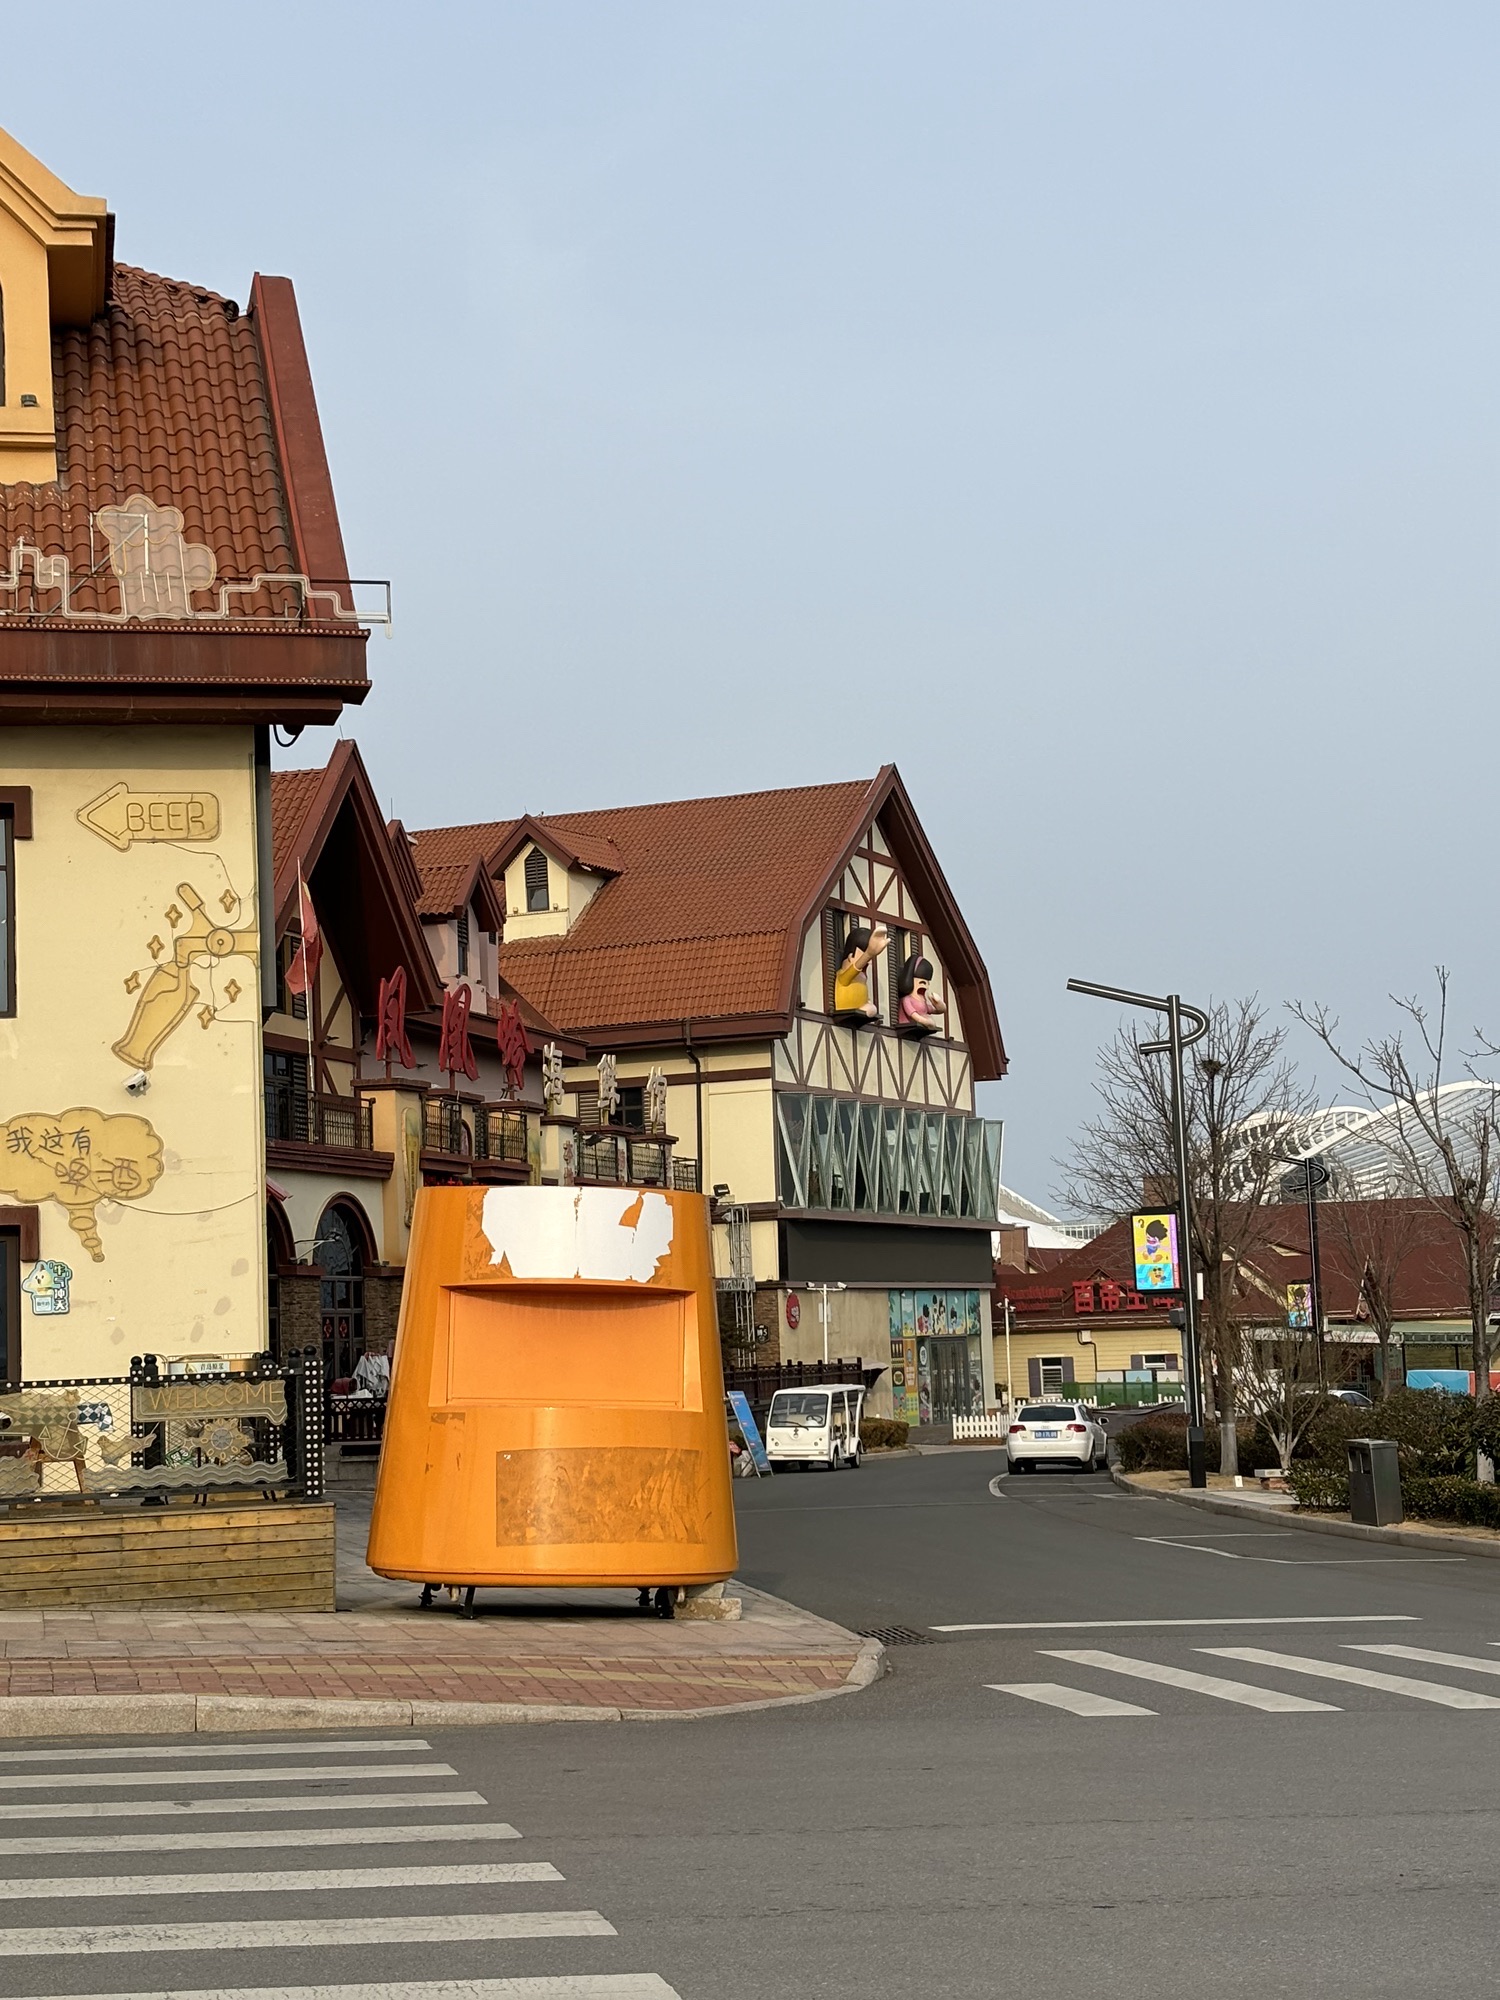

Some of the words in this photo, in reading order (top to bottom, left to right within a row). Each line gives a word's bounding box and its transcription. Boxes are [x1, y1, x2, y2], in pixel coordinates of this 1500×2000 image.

[126, 801, 205, 832] BEER
[6, 1126, 91, 1156] 我这有
[54, 1157, 142, 1197] 啤酒
[149, 1382, 285, 1410] WELCOME
